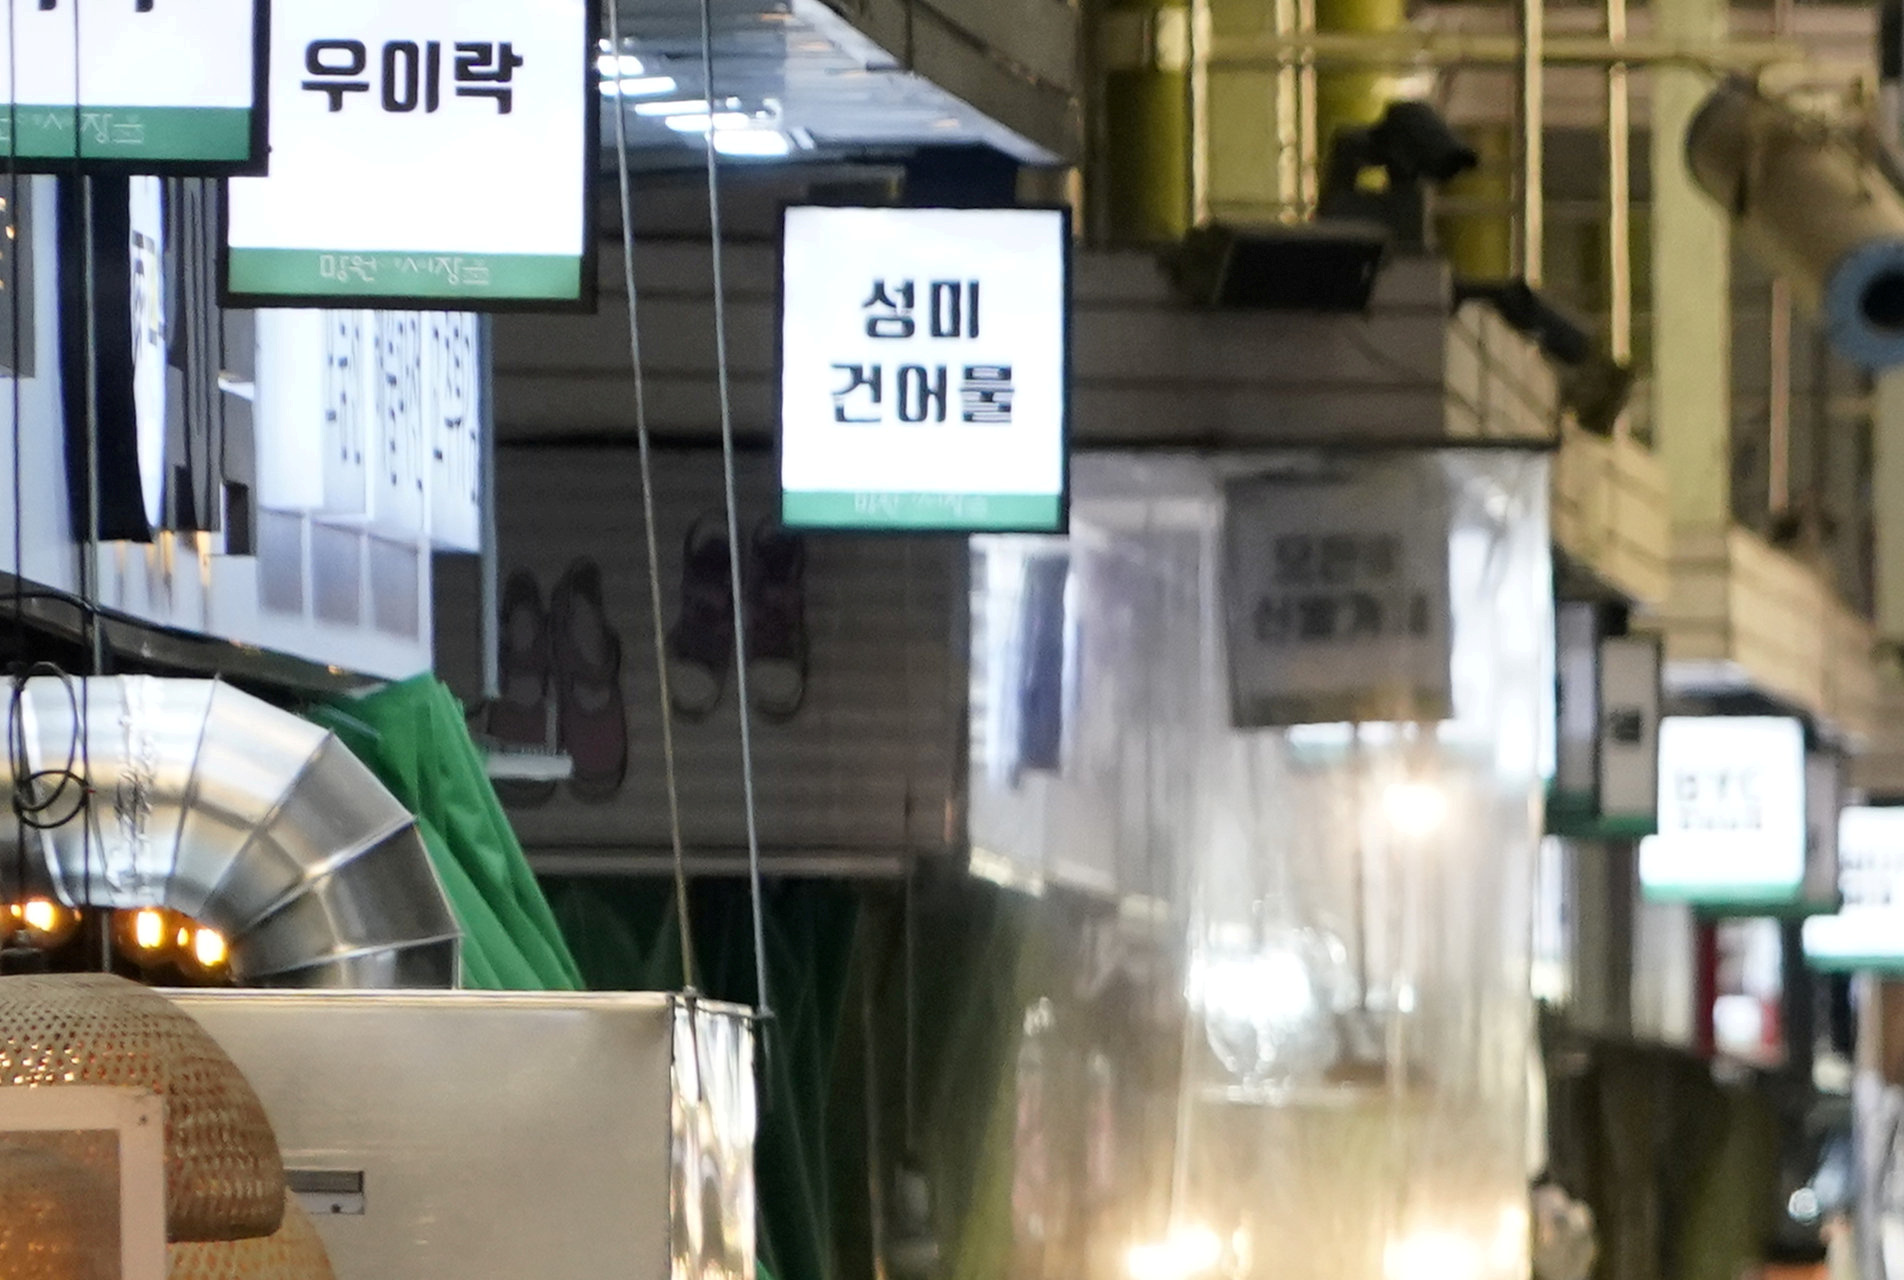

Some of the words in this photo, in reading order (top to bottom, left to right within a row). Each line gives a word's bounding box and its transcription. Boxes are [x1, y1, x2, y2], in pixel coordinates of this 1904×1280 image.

[301, 39, 524, 115] 우이락
[861, 278, 980, 339] 성미
[829, 363, 1015, 424] 건어물
